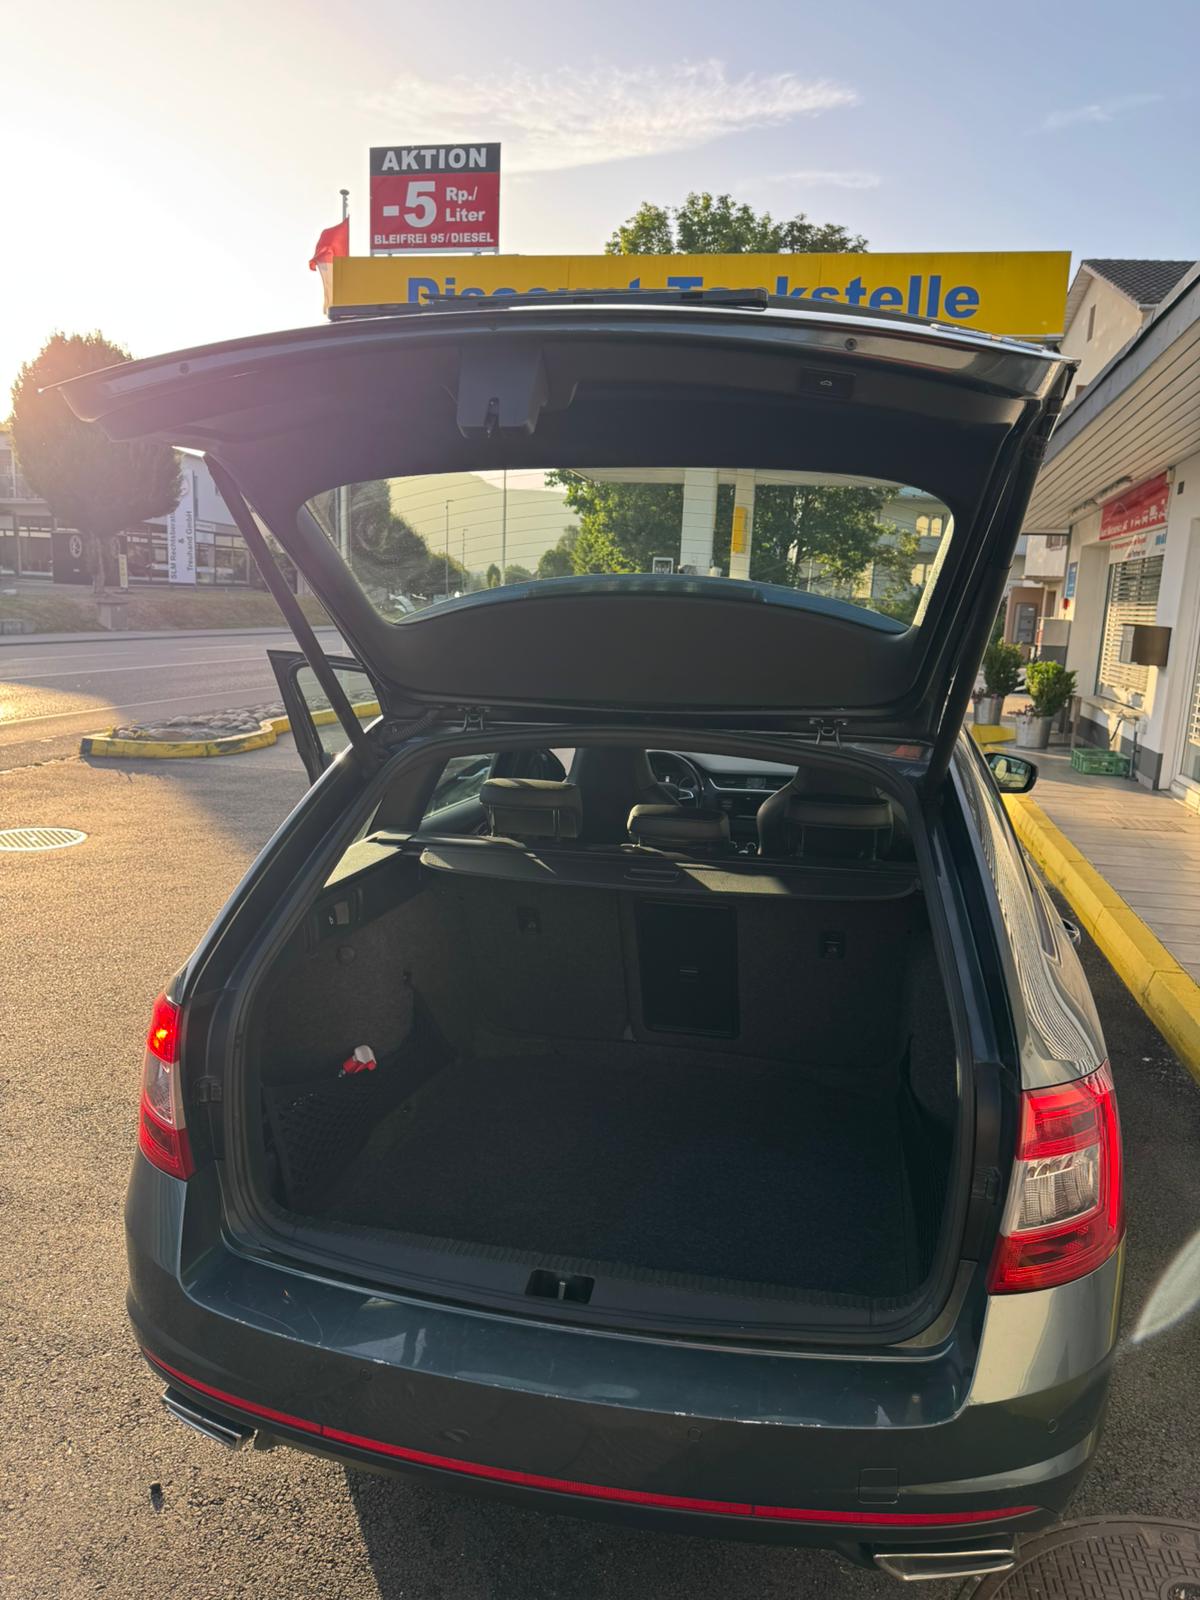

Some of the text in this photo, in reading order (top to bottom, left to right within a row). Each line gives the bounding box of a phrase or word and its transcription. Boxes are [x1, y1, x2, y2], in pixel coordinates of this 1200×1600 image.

[381, 147, 487, 171] AKTION
[445, 186, 478, 204] Rp./
[383, 181, 437, 228] -5
[445, 208, 486, 222] Liter
[374, 233, 427, 245] BLEIFREI
[667, 274, 981, 318] kstelle
[169, 562, 177, 579] SLM
